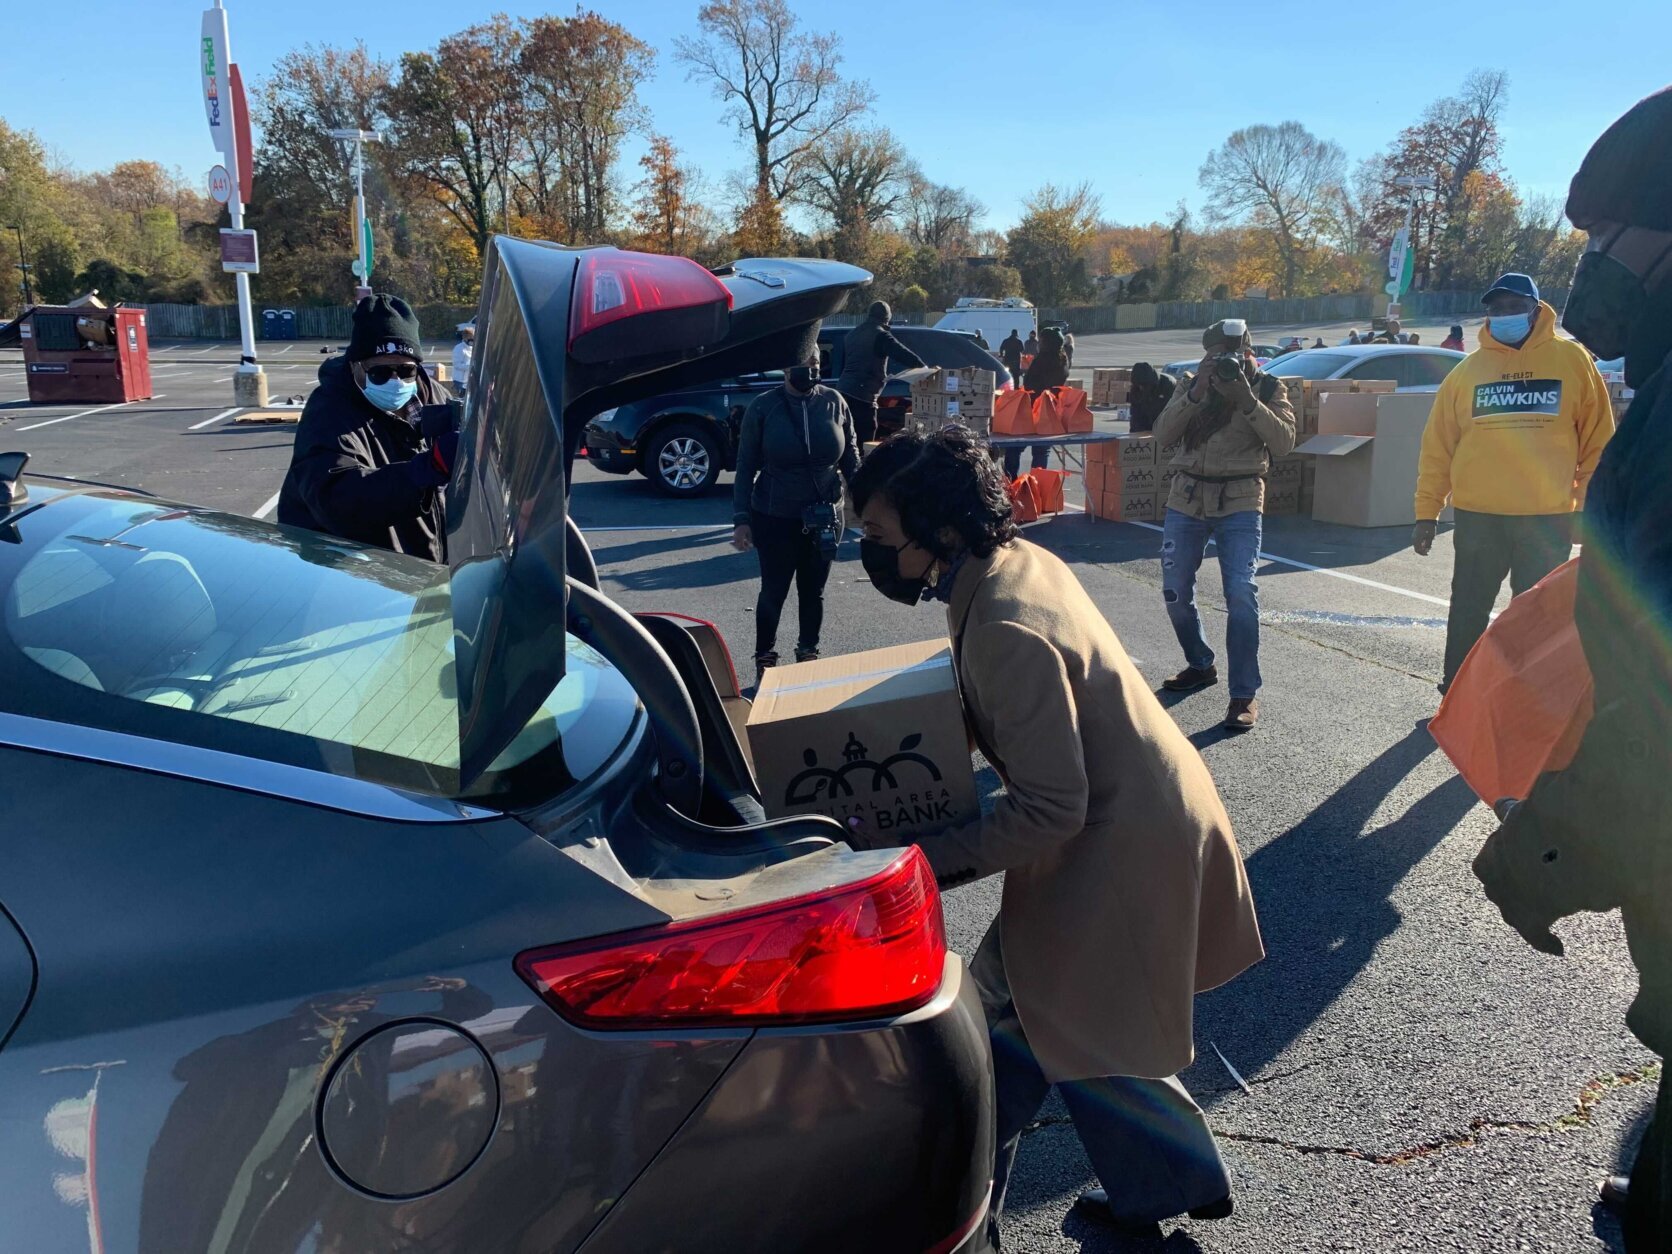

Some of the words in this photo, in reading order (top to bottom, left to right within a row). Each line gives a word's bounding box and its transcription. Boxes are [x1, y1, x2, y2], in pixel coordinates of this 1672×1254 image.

[203, 37, 220, 126] FedExField
[213, 178, 227, 191] A41
[1502, 371, 1533, 380] RE-ELECT
[1477, 385, 1514, 395] CALVIN
[1476, 391, 1558, 408] HAWKINS
[803, 800, 878, 815] PITAL
[895, 788, 950, 805] AREA
